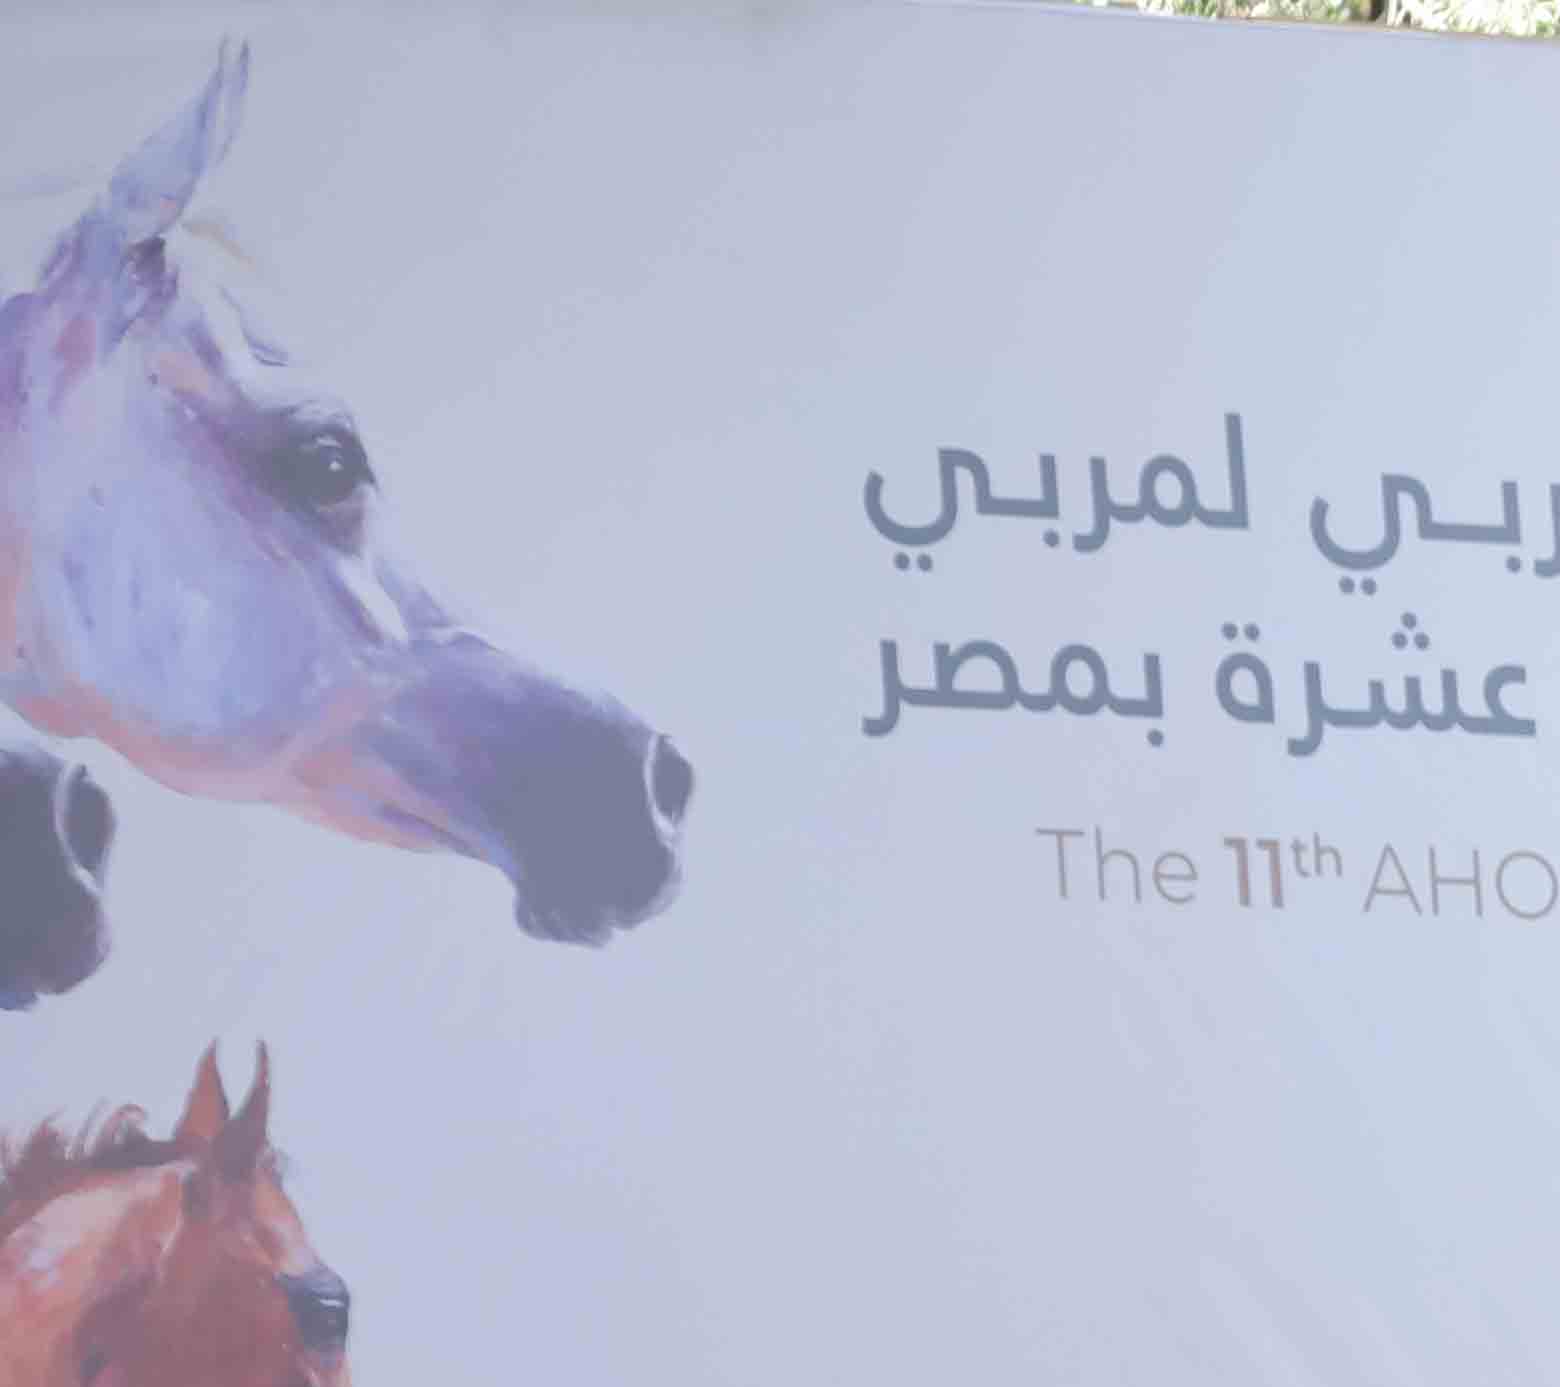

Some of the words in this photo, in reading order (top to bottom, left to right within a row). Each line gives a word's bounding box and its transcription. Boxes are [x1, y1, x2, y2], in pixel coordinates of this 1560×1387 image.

[864, 412, 1250, 574] لمربي
[861, 639, 1165, 748] بمصر
[1215, 611, 1536, 758] عشرة
[1035, 826, 1198, 904] The
[1224, 832, 1342, 909] 11th
[1363, 843, 1559, 920] AHO
